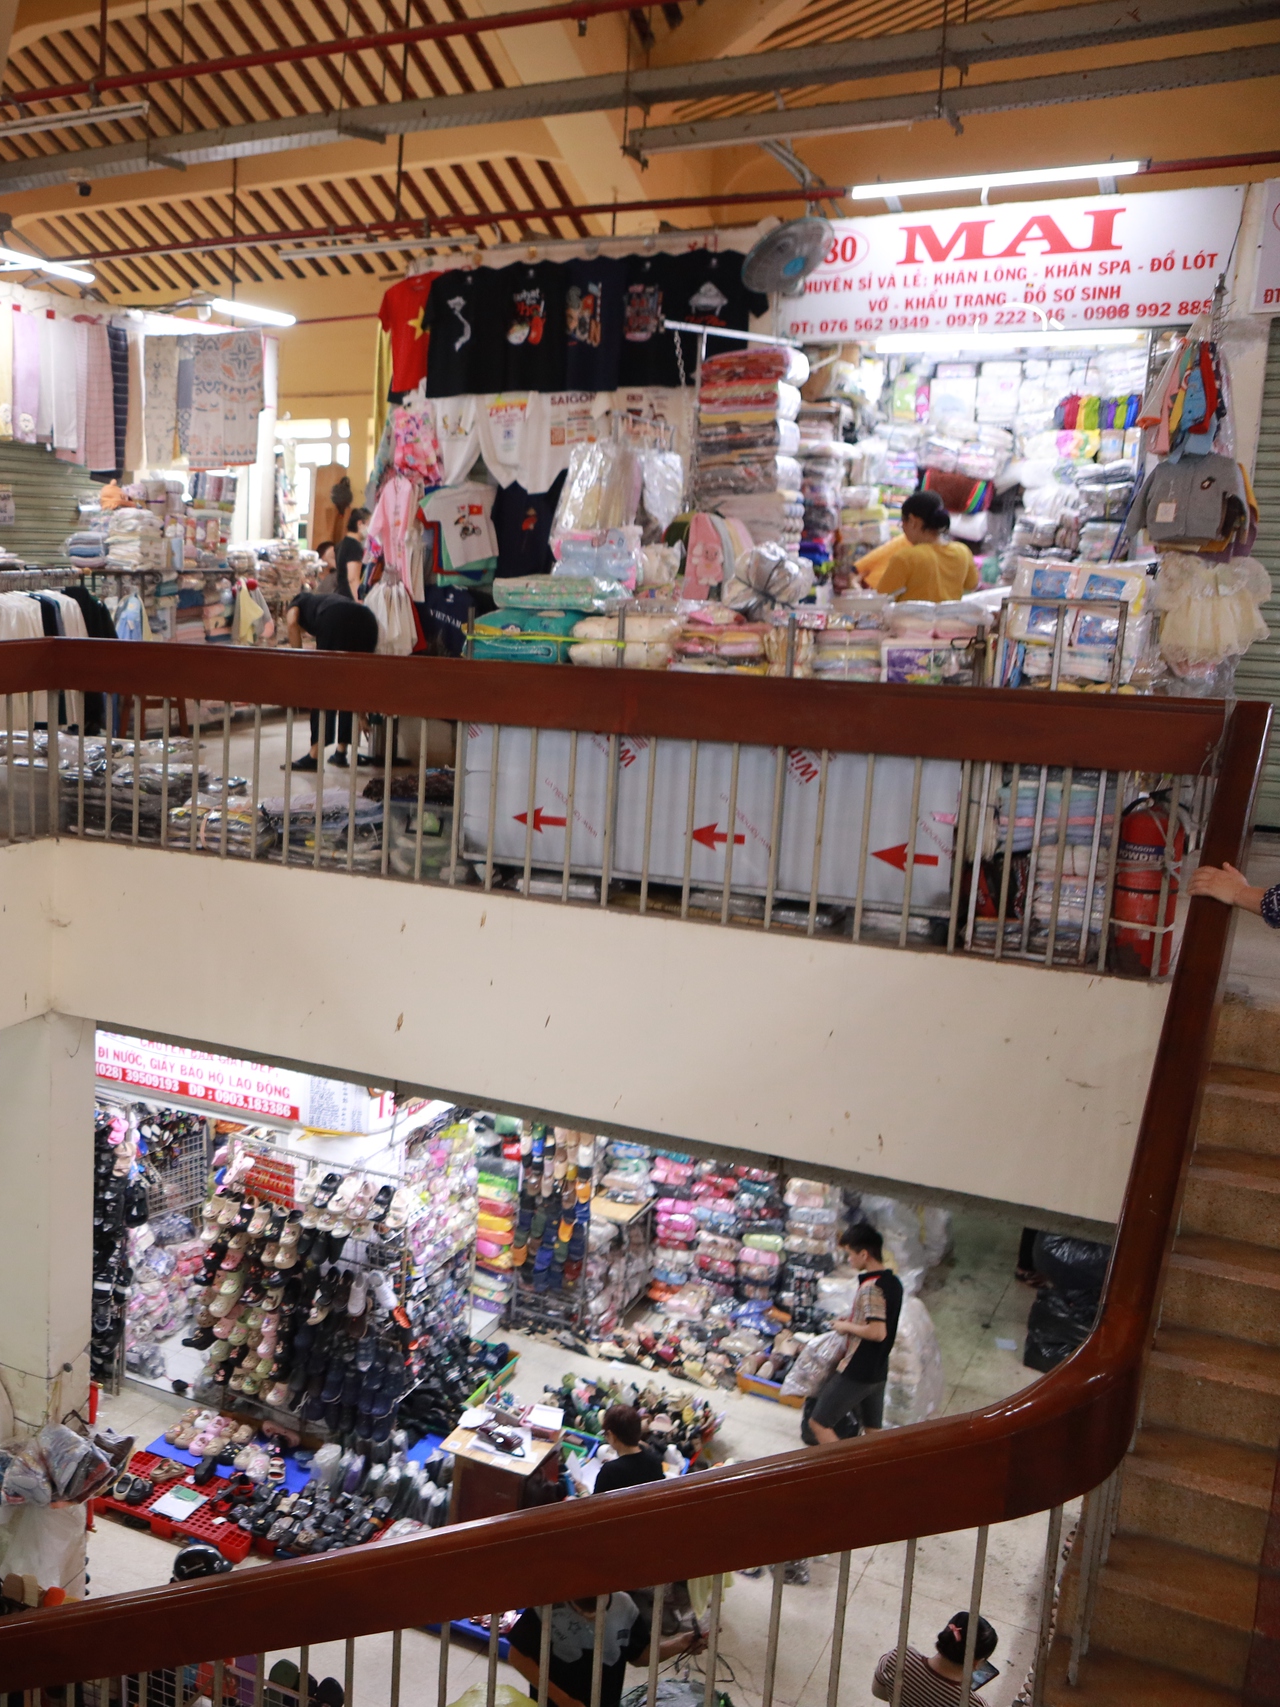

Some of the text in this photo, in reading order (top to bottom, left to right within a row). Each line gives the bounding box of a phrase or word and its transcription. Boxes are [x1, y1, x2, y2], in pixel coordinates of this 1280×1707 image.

[896, 208, 1127, 265] MAI
[804, 274, 853, 294] HUYÊN
[878, 272, 896, 289] VÀ
[984, 267, 1028, 284] LÔNG
[1045, 260, 1092, 279] KHĂN
[1098, 260, 1132, 275] SPA
[1183, 251, 1219, 270] LÓT
[820, 319, 848, 333] 076
[855, 317, 883, 332] 562
[890, 313, 929, 330] 9349
[995, 309, 1027, 325] 222
[1136, 302, 1171, 317] 992
[869, 296, 889, 312] VỚ
[905, 289, 948, 309] KHẨU
[955, 292, 1007, 308] TRANG
[1054, 286, 1076, 302] SƠ
[1081, 285, 1121, 301] SINH
[430, 609, 462, 629] VIETNAM
[96, 1063, 123, 1080] (028)
[125, 1070, 180, 1092] 39509193
[214, 1088, 292, 1118] 0903.183386
[98, 1046, 109, 1059] ĐI
[229, 1075, 252, 1092] LAO
[256, 1080, 290, 1100] ĐỘNG
